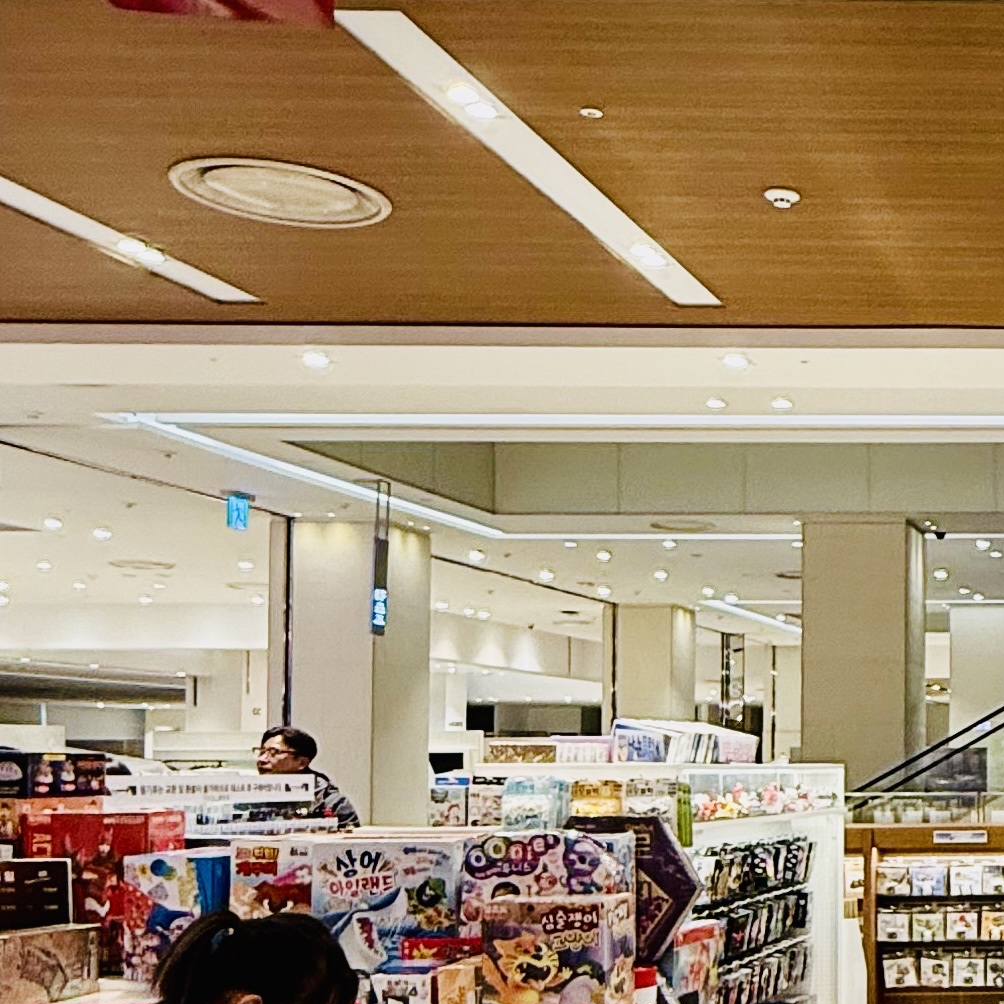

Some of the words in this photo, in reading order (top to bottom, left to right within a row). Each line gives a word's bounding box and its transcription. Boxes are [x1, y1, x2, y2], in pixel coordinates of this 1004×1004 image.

[336, 850, 382, 879] 상어
[329, 876, 396, 896] 아일랜드
[541, 909, 598, 931] 심술쟁이
